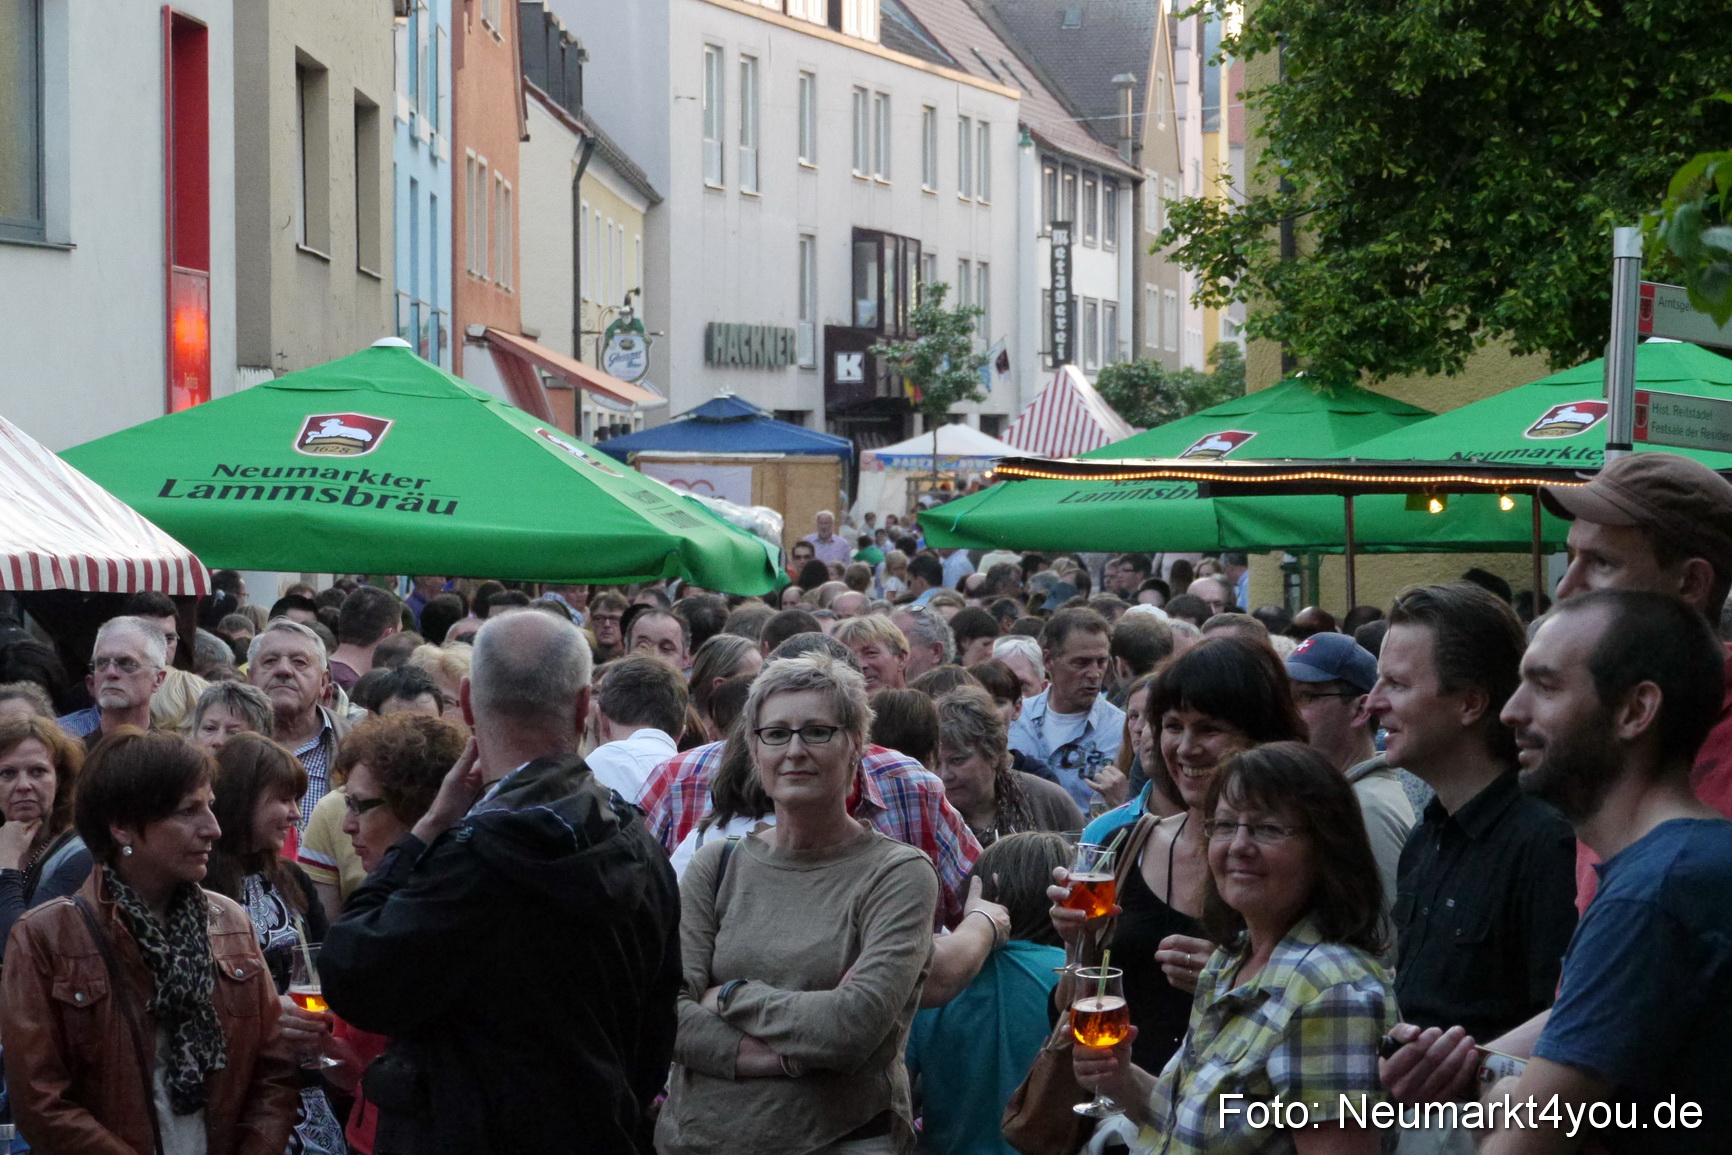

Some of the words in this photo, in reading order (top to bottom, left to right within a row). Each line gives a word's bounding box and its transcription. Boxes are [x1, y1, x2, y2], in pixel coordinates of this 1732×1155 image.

[1053, 229, 1069, 360] Metzgerei
[705, 322, 797, 369] HACKNER
[836, 353, 862, 381] K
[1673, 404, 1713, 421] Reitstadel
[1685, 426, 1698, 438] der
[313, 445, 351, 454] 1628
[1449, 446, 1605, 462] Neumarkte
[211, 463, 431, 490] Neumarkter
[157, 478, 459, 516] Lammsbräu
[1057, 485, 1199, 504] Lammsbr
